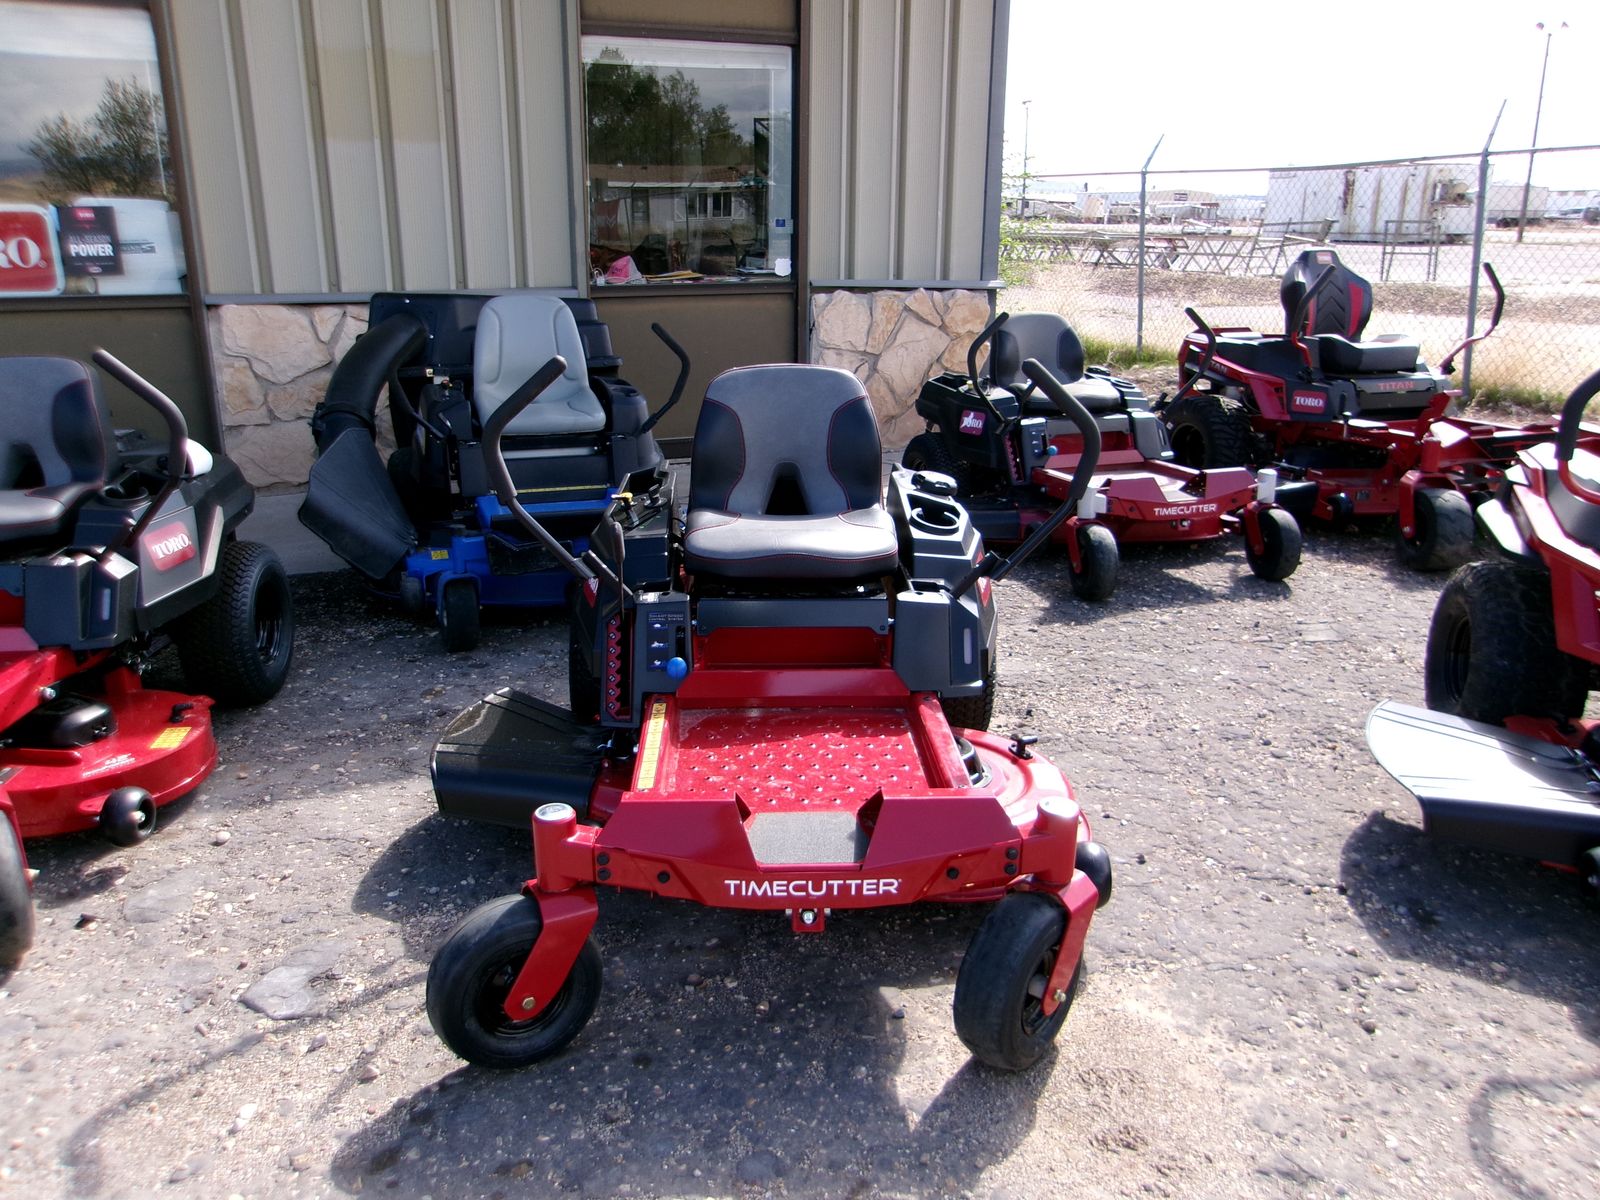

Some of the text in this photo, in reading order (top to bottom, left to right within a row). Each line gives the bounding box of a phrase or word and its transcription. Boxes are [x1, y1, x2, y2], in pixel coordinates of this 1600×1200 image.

[0, 237, 42, 269] O
[70, 244, 114, 257] POWER
[1376, 382, 1414, 391] TITAN
[1295, 396, 1323, 407] TORO
[1153, 503, 1217, 516] TIMECUTTER
[152, 533, 190, 559] TORO
[724, 878, 899, 896] TIMECUTTER
